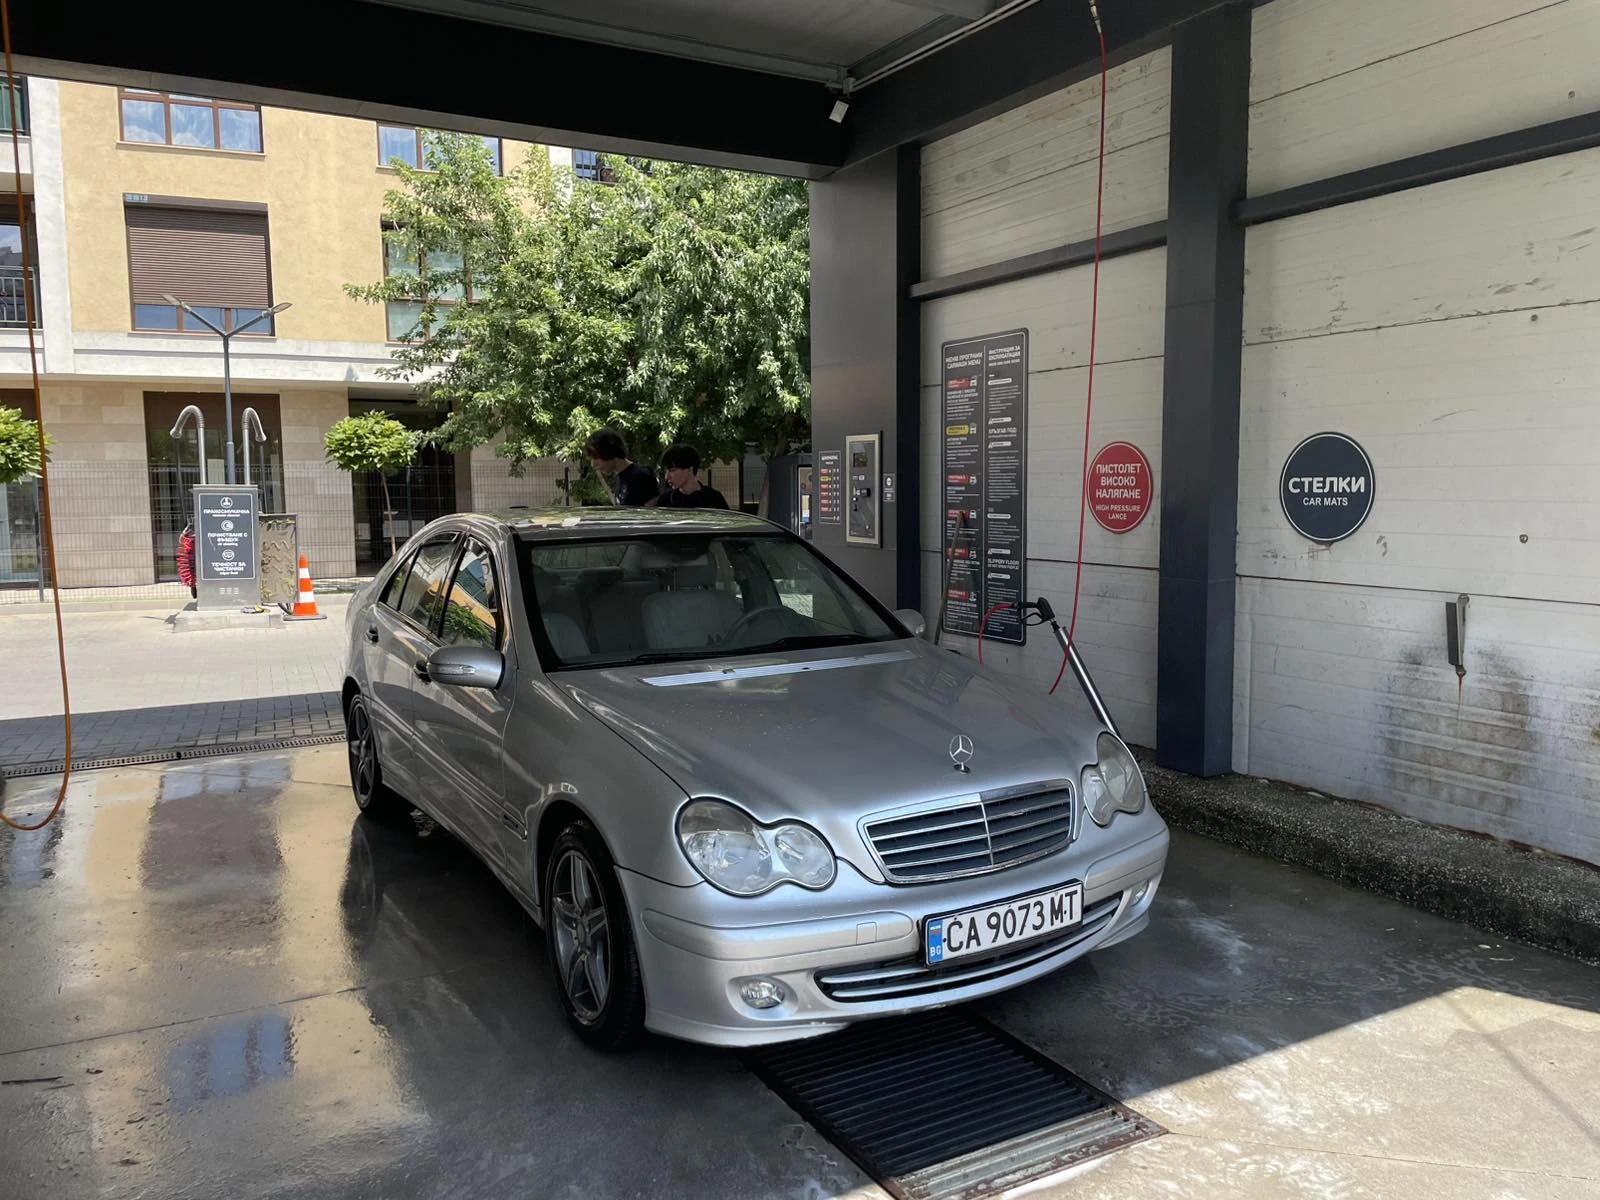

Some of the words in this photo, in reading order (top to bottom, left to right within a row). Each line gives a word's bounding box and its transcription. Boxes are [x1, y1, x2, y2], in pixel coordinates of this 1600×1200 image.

[1096, 464, 1141, 473] ПИСТОЛЕТ
[1101, 476, 1136, 486] ВИСОКО
[1288, 477, 1365, 493] СТЕЛКИ
[1096, 489, 1140, 498] НАЛЯГАНЕ
[1303, 498, 1321, 506] CAR
[1324, 498, 1348, 506] MATS
[947, 917, 981, 952] CA
[986, 901, 1045, 943] 9073
[1050, 890, 1078, 926] MT
[930, 945, 941, 956] BG
